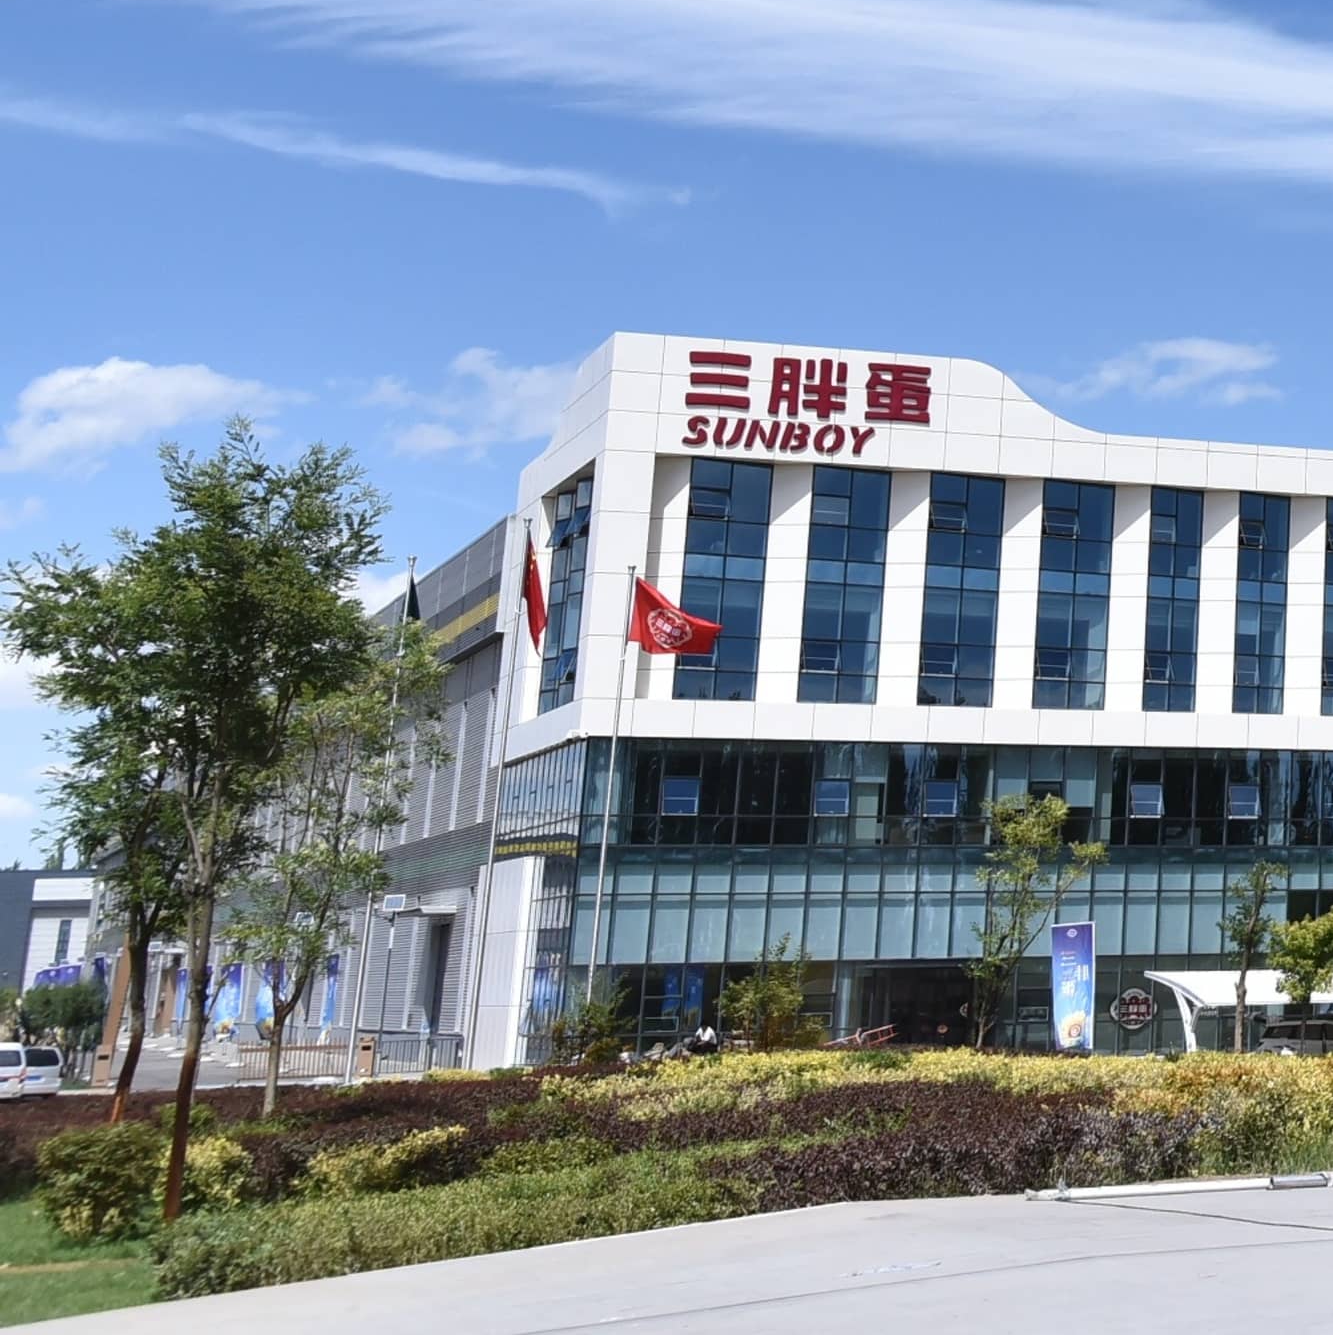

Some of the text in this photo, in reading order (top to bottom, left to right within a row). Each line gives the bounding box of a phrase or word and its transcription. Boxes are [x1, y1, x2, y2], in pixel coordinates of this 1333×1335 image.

[685, 351, 932, 426] 三胖蛋
[682, 416, 875, 458] SUNBOY
